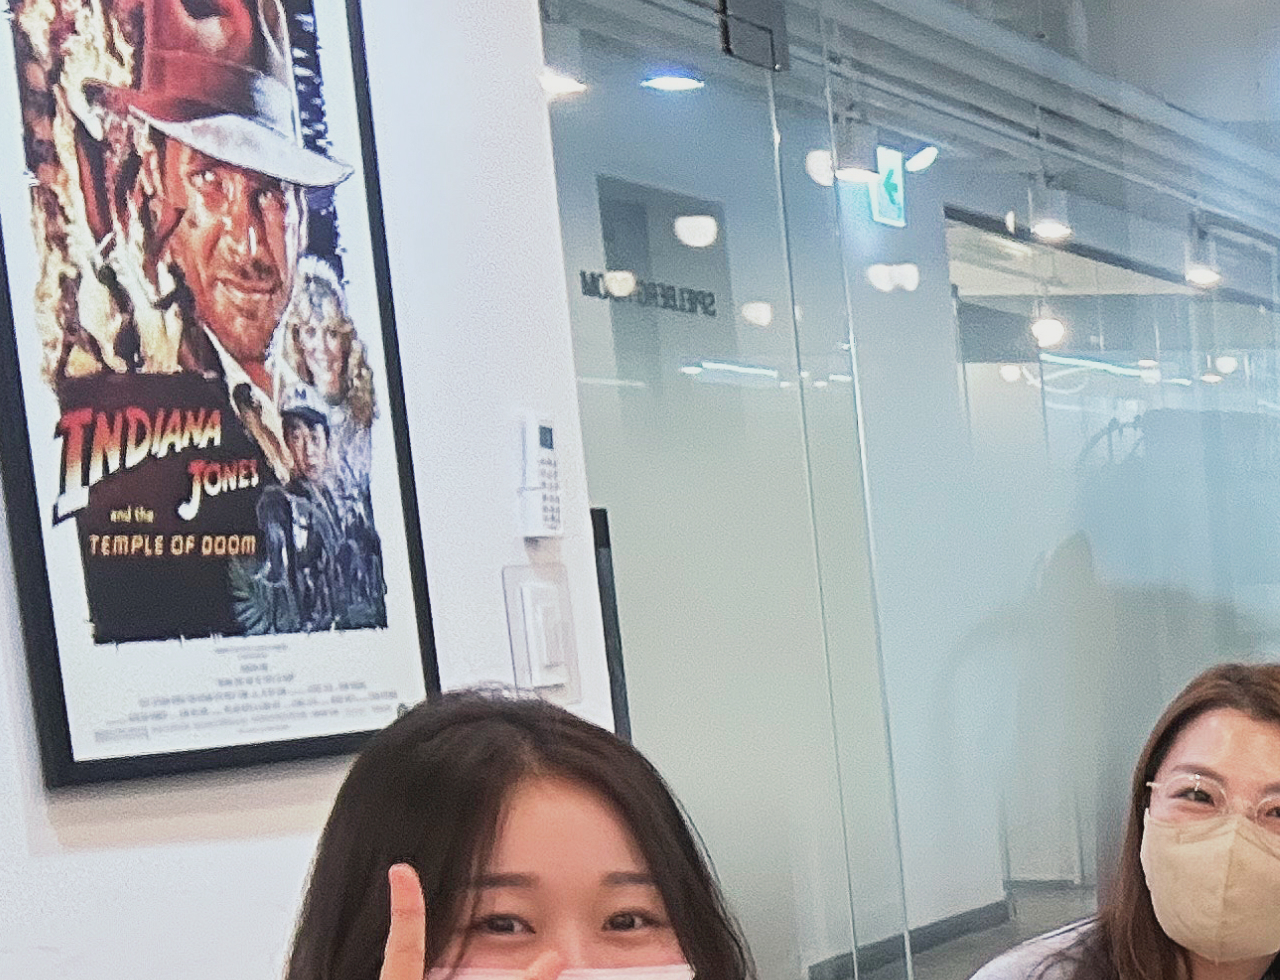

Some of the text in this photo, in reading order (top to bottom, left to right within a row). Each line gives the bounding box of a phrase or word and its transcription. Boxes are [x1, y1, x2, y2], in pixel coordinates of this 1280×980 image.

[52, 405, 223, 527] INDIANA
[177, 458, 260, 521] JONES
[134, 506, 155, 523] the
[89, 533, 257, 557] TEMPLE OF DOOM
